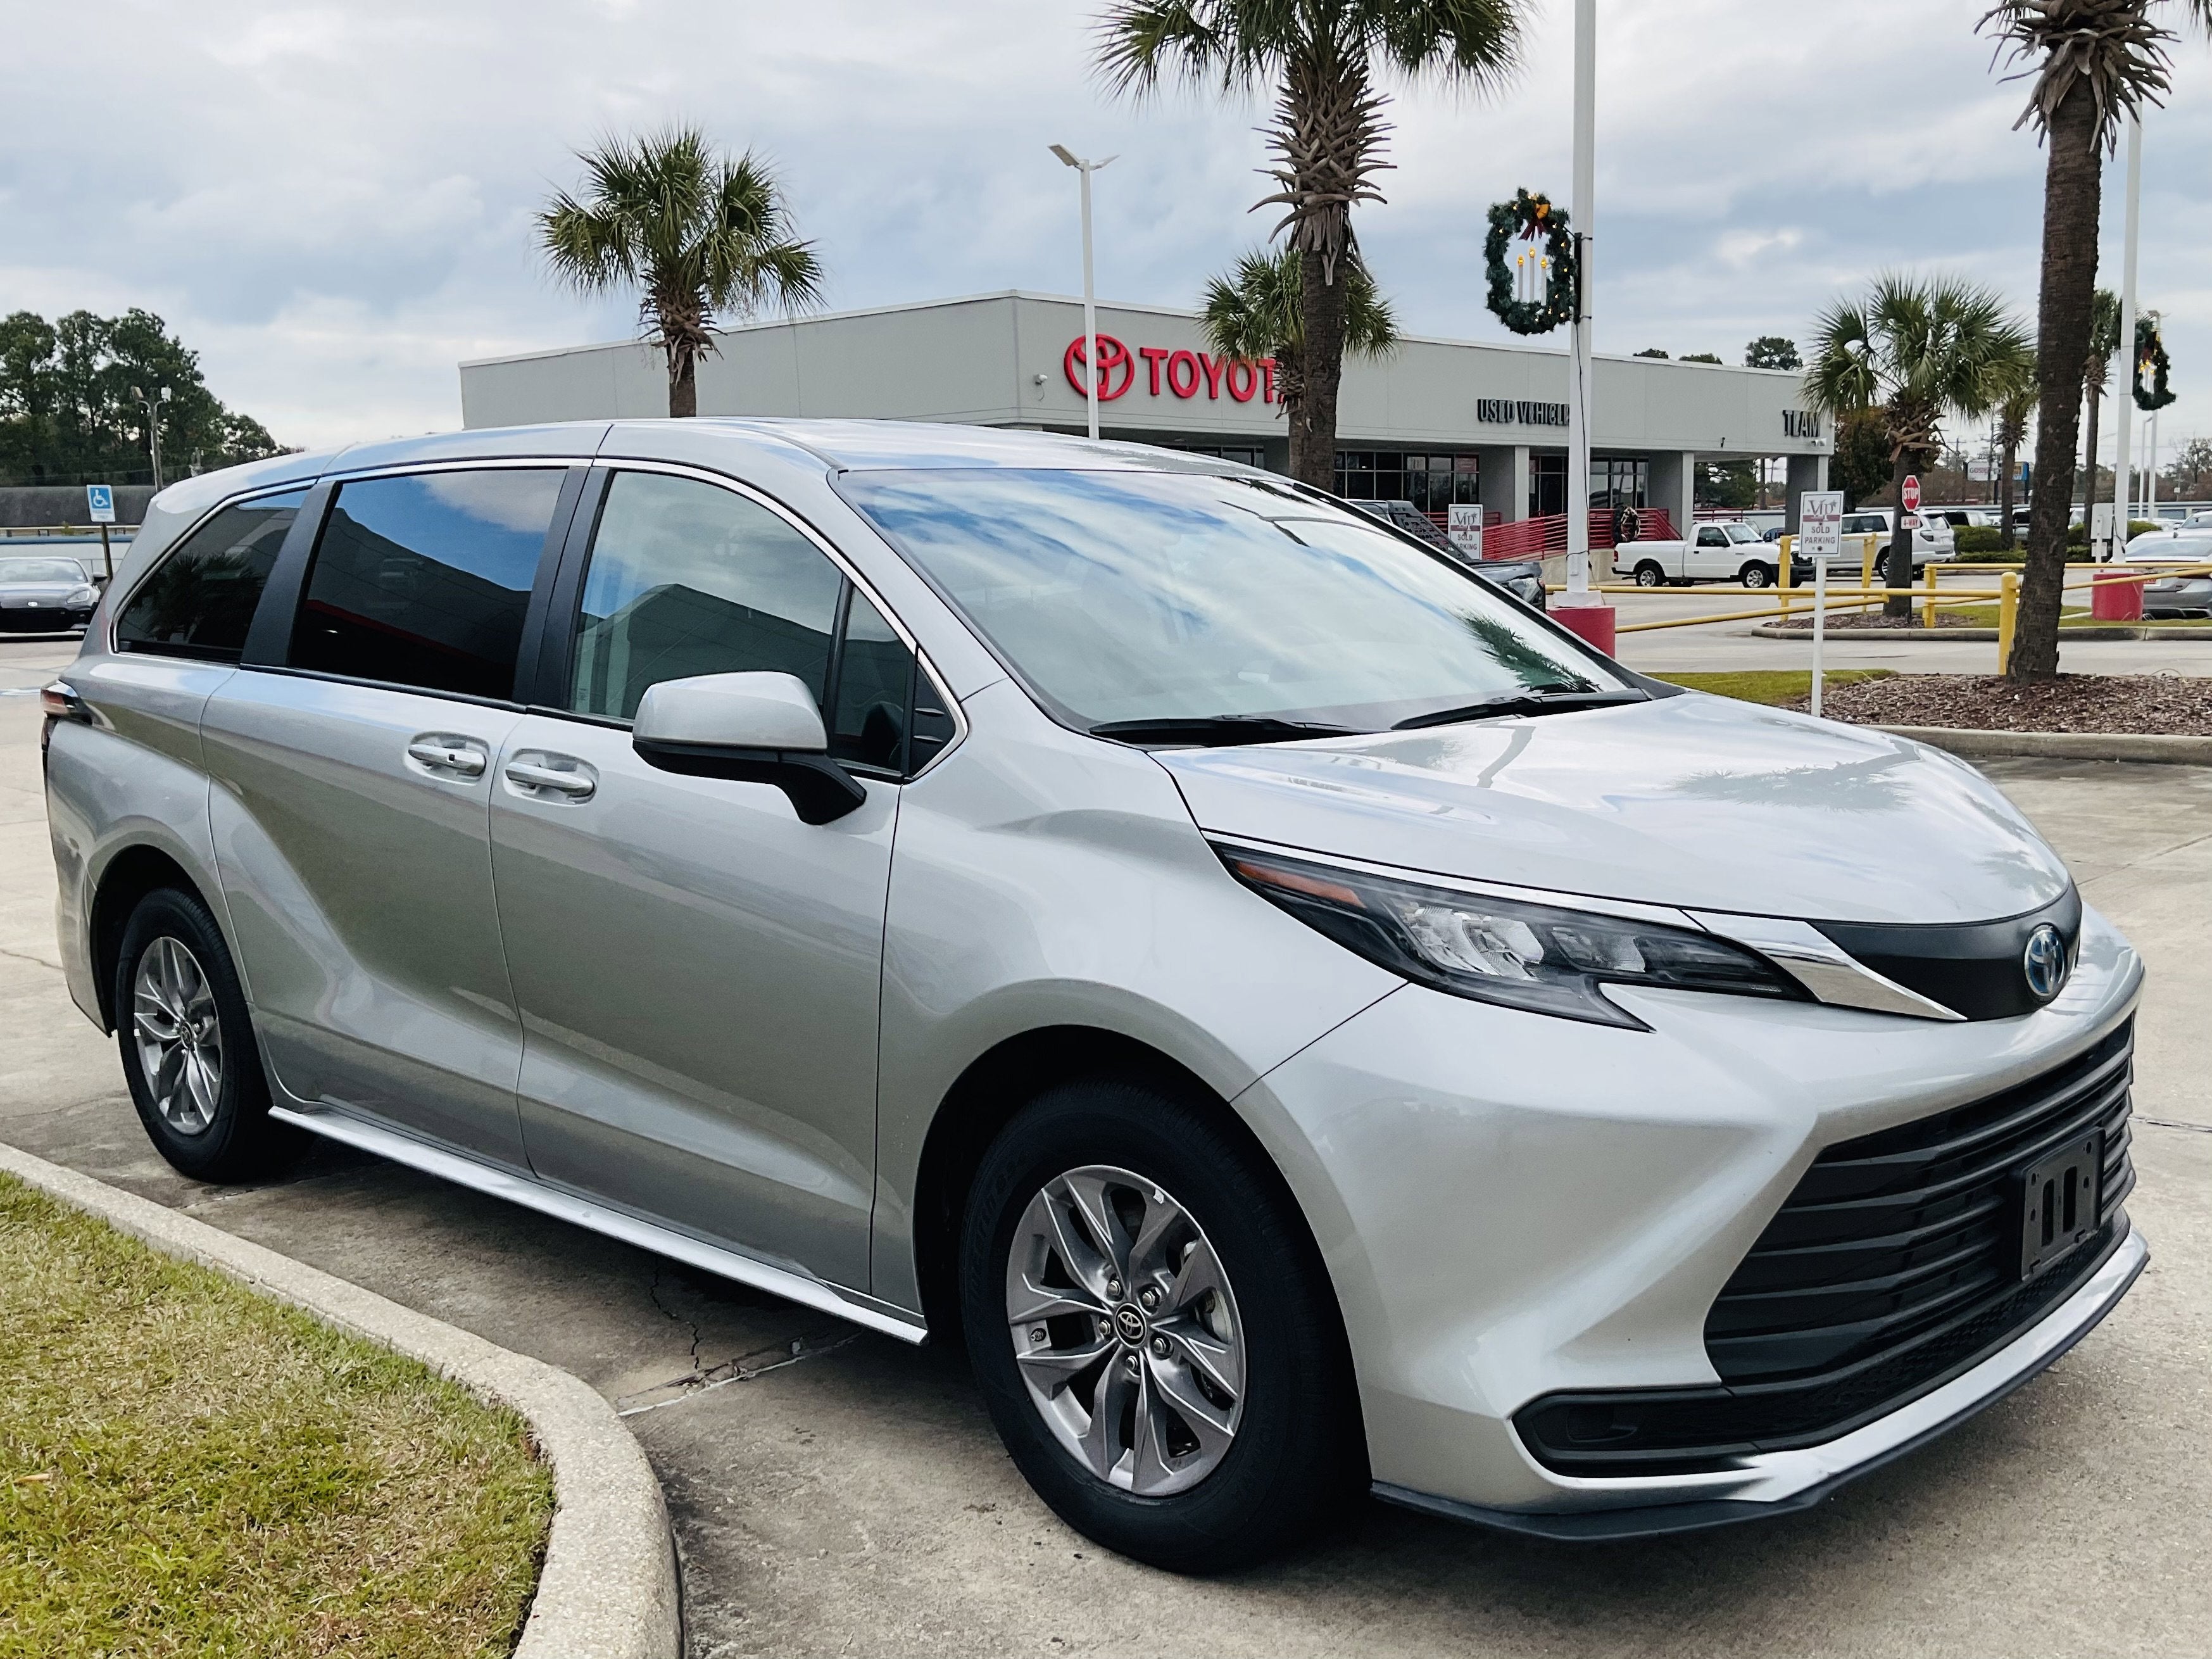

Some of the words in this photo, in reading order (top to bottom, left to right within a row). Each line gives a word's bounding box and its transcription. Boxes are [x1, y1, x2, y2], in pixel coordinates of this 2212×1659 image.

[1140, 347, 1285, 403] TOYOT
[1477, 399, 1515, 423] USED
[1516, 401, 1569, 426] VEHICLE
[1782, 410, 1821, 437] TEAM
[1904, 487, 1918, 500] STOP
